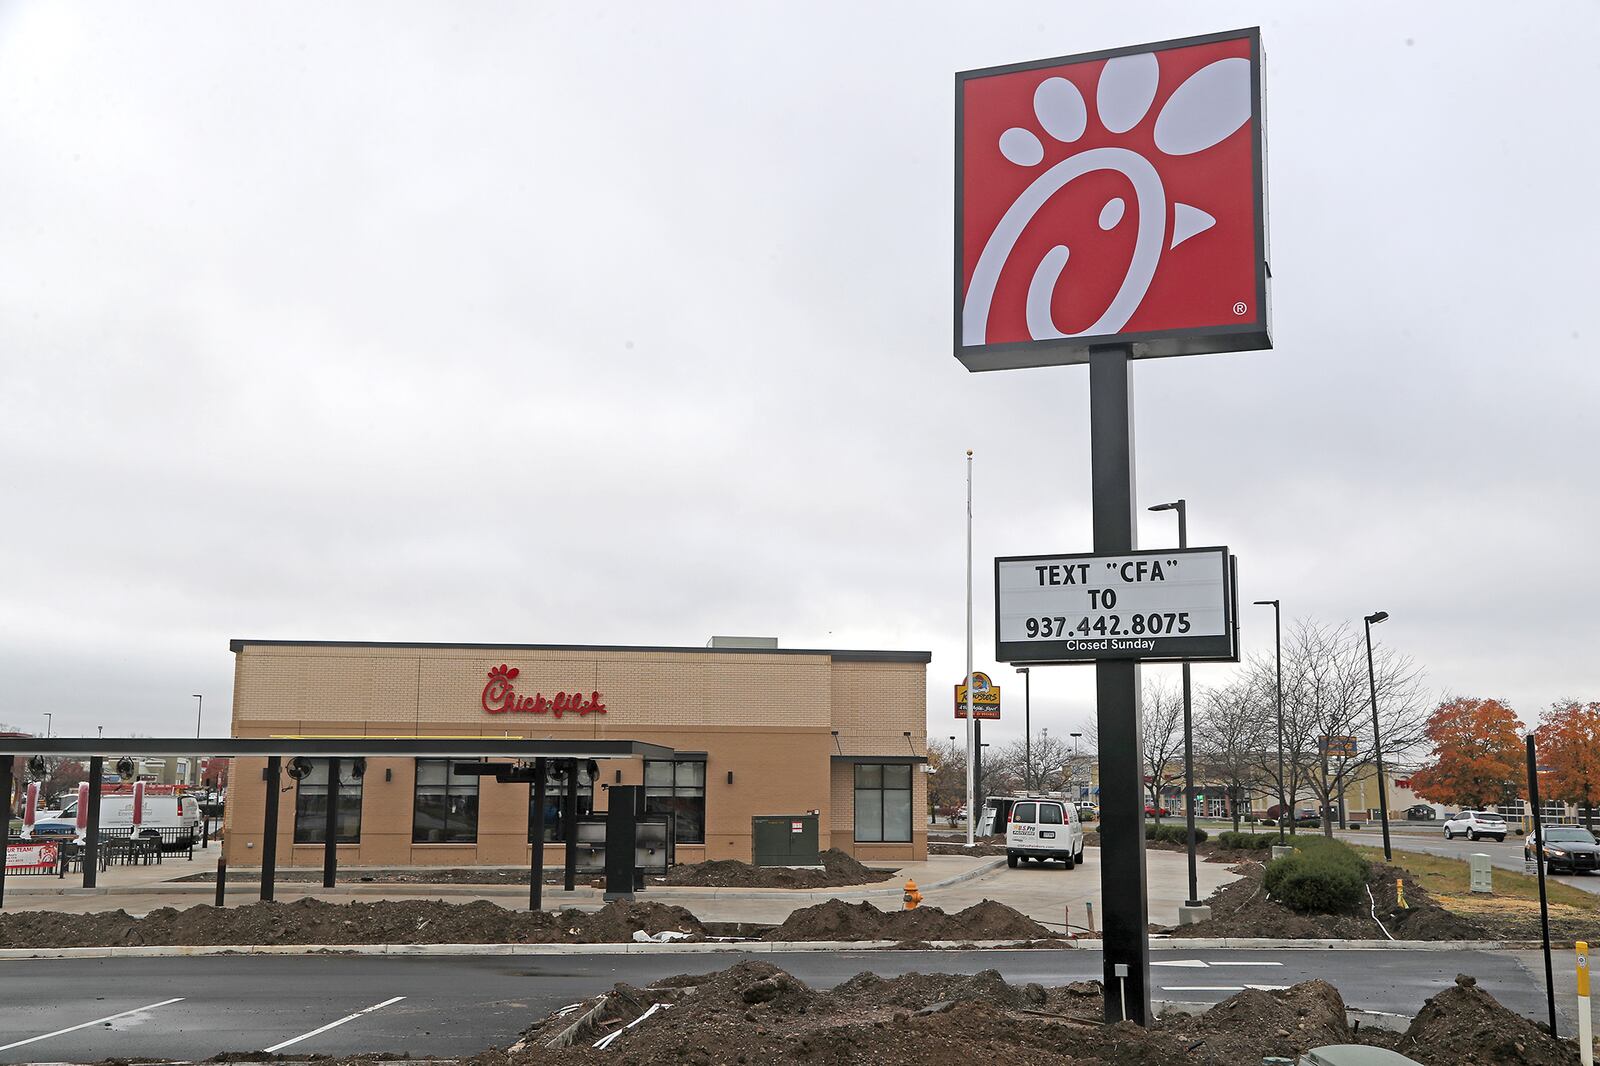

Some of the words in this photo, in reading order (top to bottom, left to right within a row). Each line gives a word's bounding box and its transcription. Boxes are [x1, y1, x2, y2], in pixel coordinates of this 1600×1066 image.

[1035, 563, 1091, 586] TEXT
[1088, 588, 1117, 610] TO
[1025, 612, 1191, 639] 937.442.8075
[1066, 639, 1109, 651] Closed
[1111, 638, 1155, 652] Sunday
